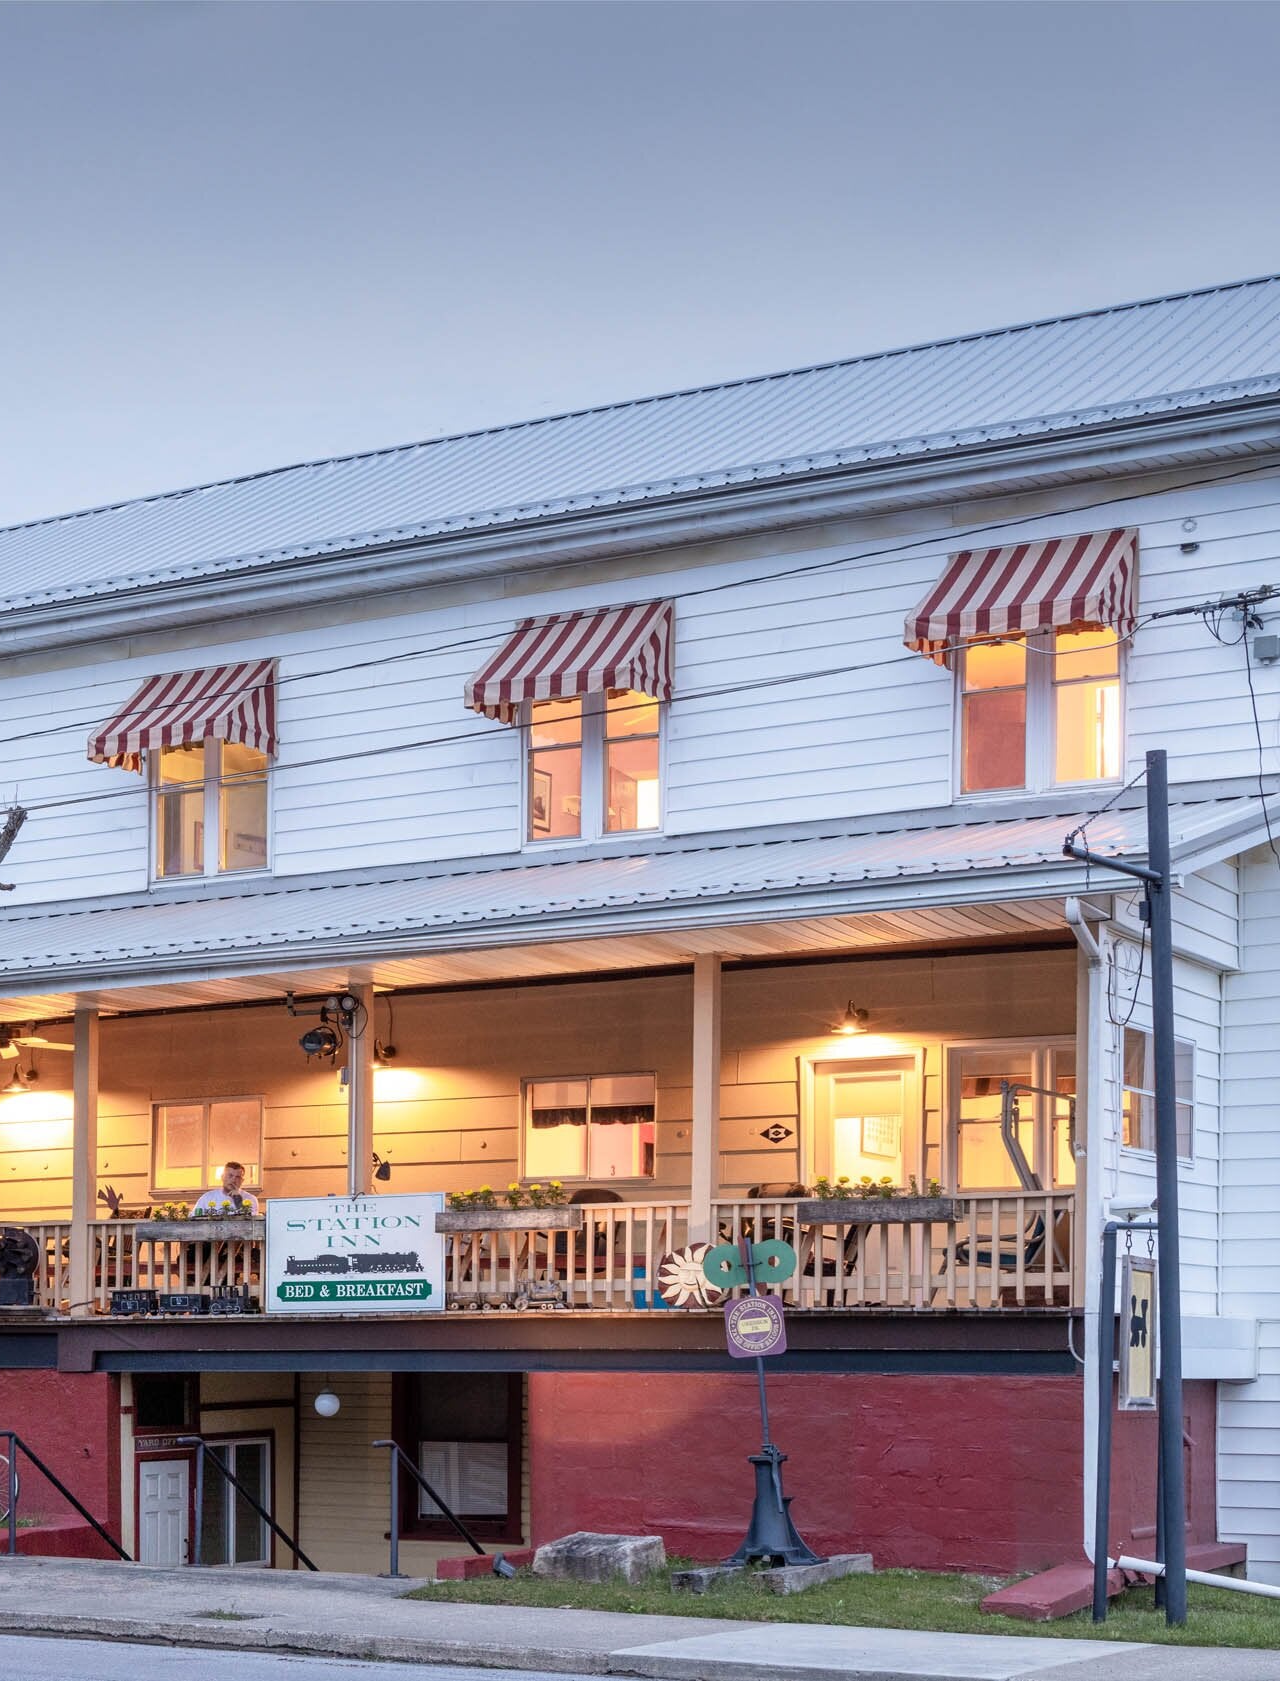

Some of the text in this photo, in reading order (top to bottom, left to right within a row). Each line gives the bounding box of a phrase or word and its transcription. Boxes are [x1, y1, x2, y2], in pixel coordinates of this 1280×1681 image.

[610, 1165, 616, 1176] 3
[329, 1203, 376, 1213] THE
[286, 1215, 423, 1231] STATION
[327, 1233, 382, 1248] INN
[285, 1283, 424, 1298] BED & BREAKFAST
[739, 1301, 767, 1311] STATION
[138, 1439, 160, 1447] YARD
